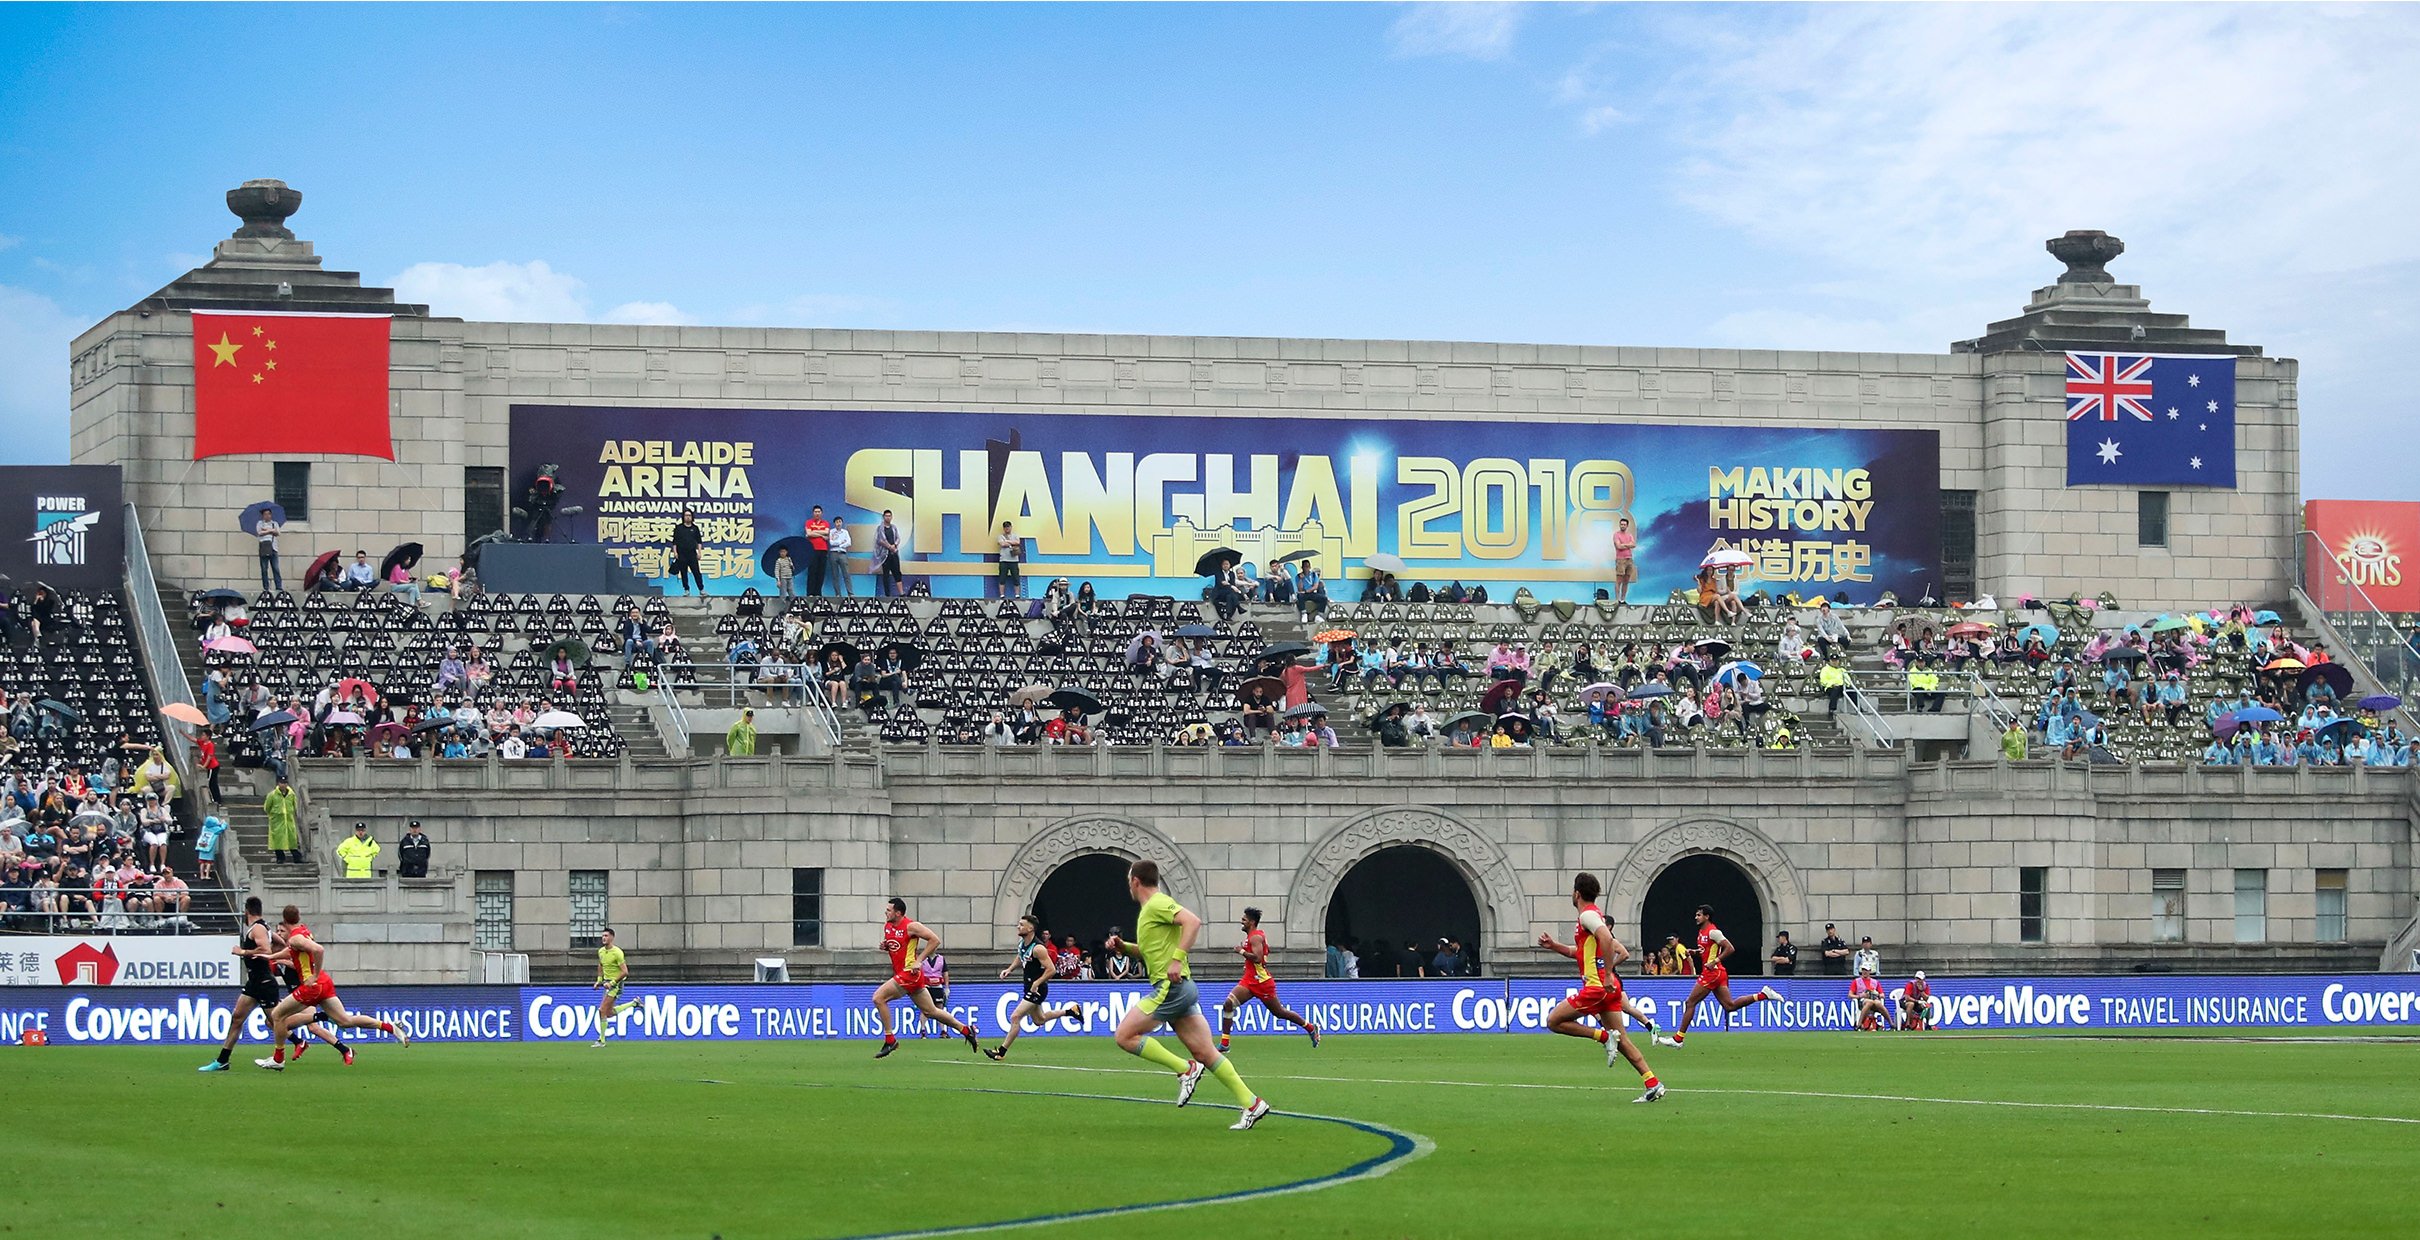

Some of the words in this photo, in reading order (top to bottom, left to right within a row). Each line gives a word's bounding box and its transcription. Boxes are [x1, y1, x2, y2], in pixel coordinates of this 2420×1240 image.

[598, 440, 754, 465] ADELAIDE
[598, 465, 754, 499] ARENA
[1709, 466, 1872, 500] MAKING
[37, 496, 86, 511] POWER
[598, 500, 683, 513] JIANGWAN
[686, 501, 753, 514] STADIUM
[845, 449, 1378, 558] SHANGHAI
[1397, 456, 1637, 562] 2018
[1709, 498, 1874, 532] HISTORY
[598, 516, 755, 544] 阿德莱球场
[2336, 554, 2403, 587] SUNS
[124, 961, 230, 980] ADELAIDE
[751, 1007, 838, 1036] TRAVEL
[1305, 1002, 1437, 1031] INSURANCE
[1667, 1000, 1753, 1027] TAVEL
[2101, 997, 2179, 1024] TRAVEL
[2186, 996, 2308, 1023] INSURANCE
